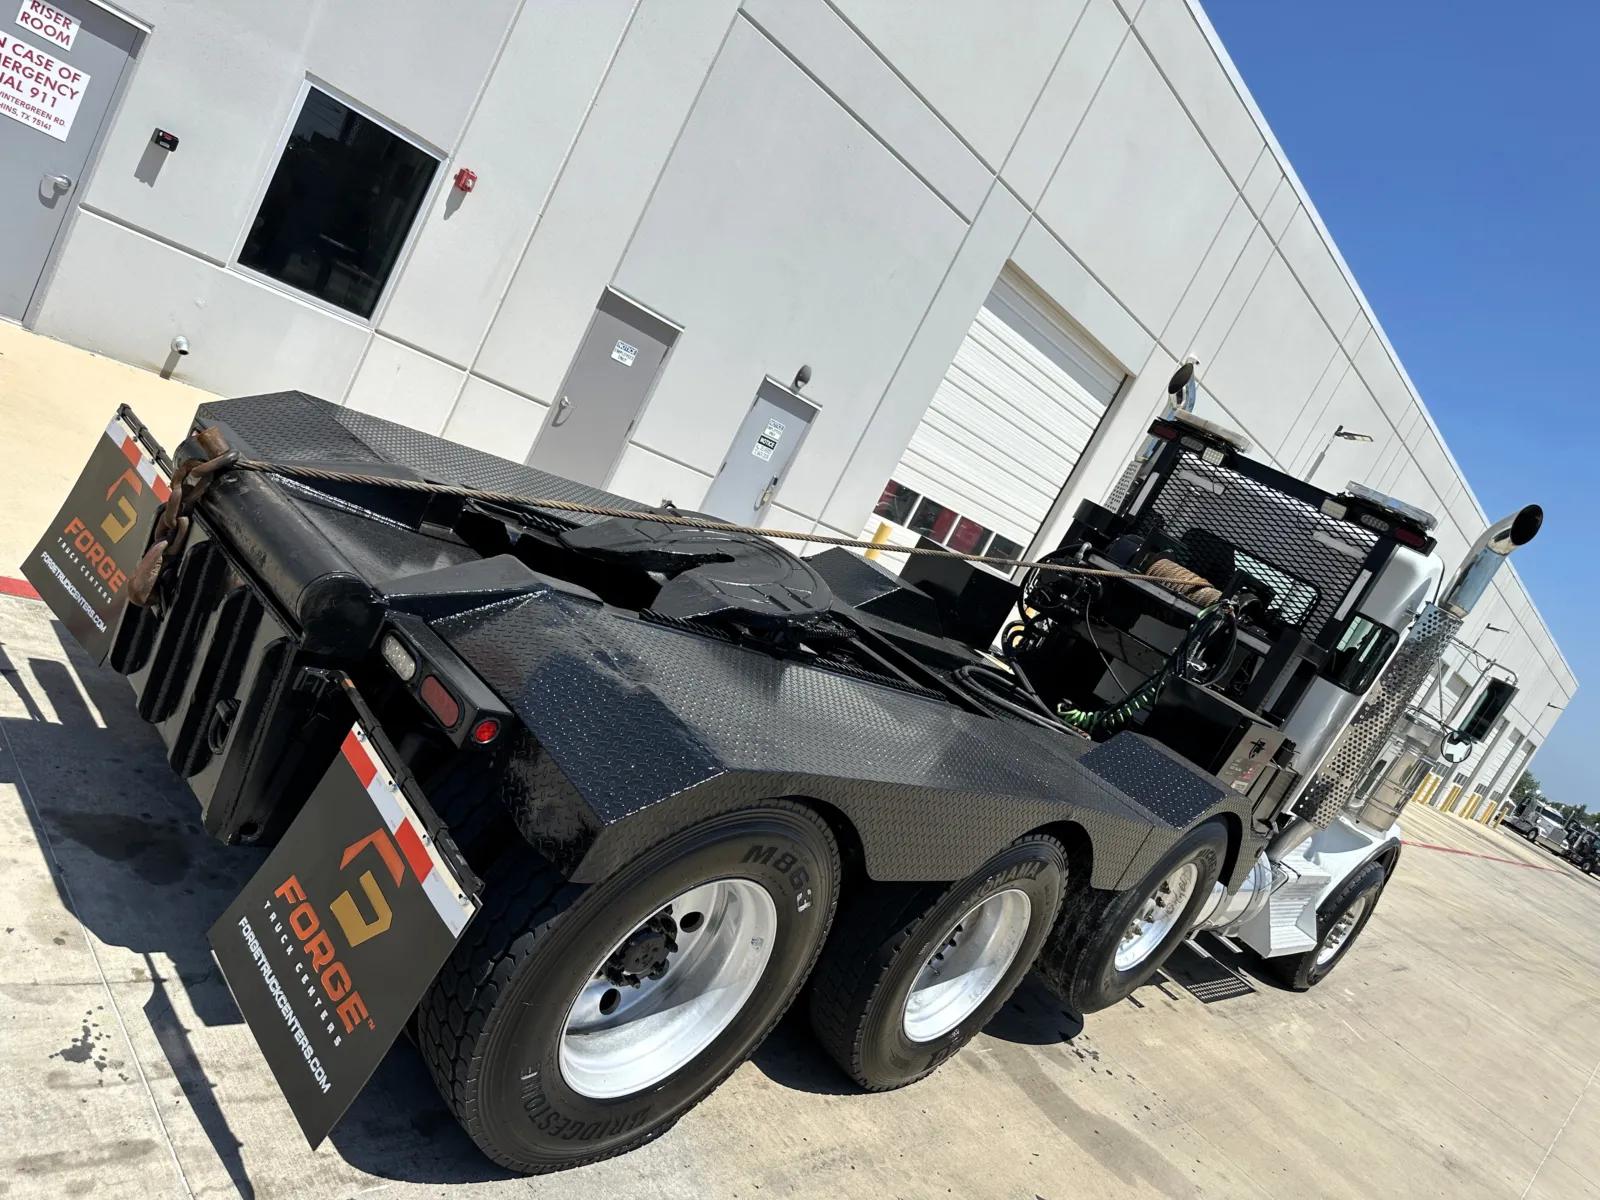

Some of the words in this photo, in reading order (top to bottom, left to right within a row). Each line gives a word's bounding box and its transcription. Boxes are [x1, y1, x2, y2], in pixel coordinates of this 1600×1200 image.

[20, 11, 70, 46] ROOM
[30, 0, 72, 30] RISER
[0, 53, 79, 100] ERGENCY
[12, 43, 54, 72] CASE
[58, 67, 81, 83] OF
[21, 111, 31, 121] TX
[32, 117, 52, 130] 75141
[30, 87, 57, 108] 911
[57, 536, 79, 564] TRUCK
[80, 564, 112, 604] CENTERS
[64, 517, 127, 593] FORGE
[41, 551, 107, 633] FORGETRUCKCENTERS.COM
[264, 900, 294, 955] TRUCK
[295, 962, 342, 1047] CENTERS
[274, 874, 369, 1034] FORGE
[238, 915, 332, 1094] FORGETRUCKCENTERS.COM
